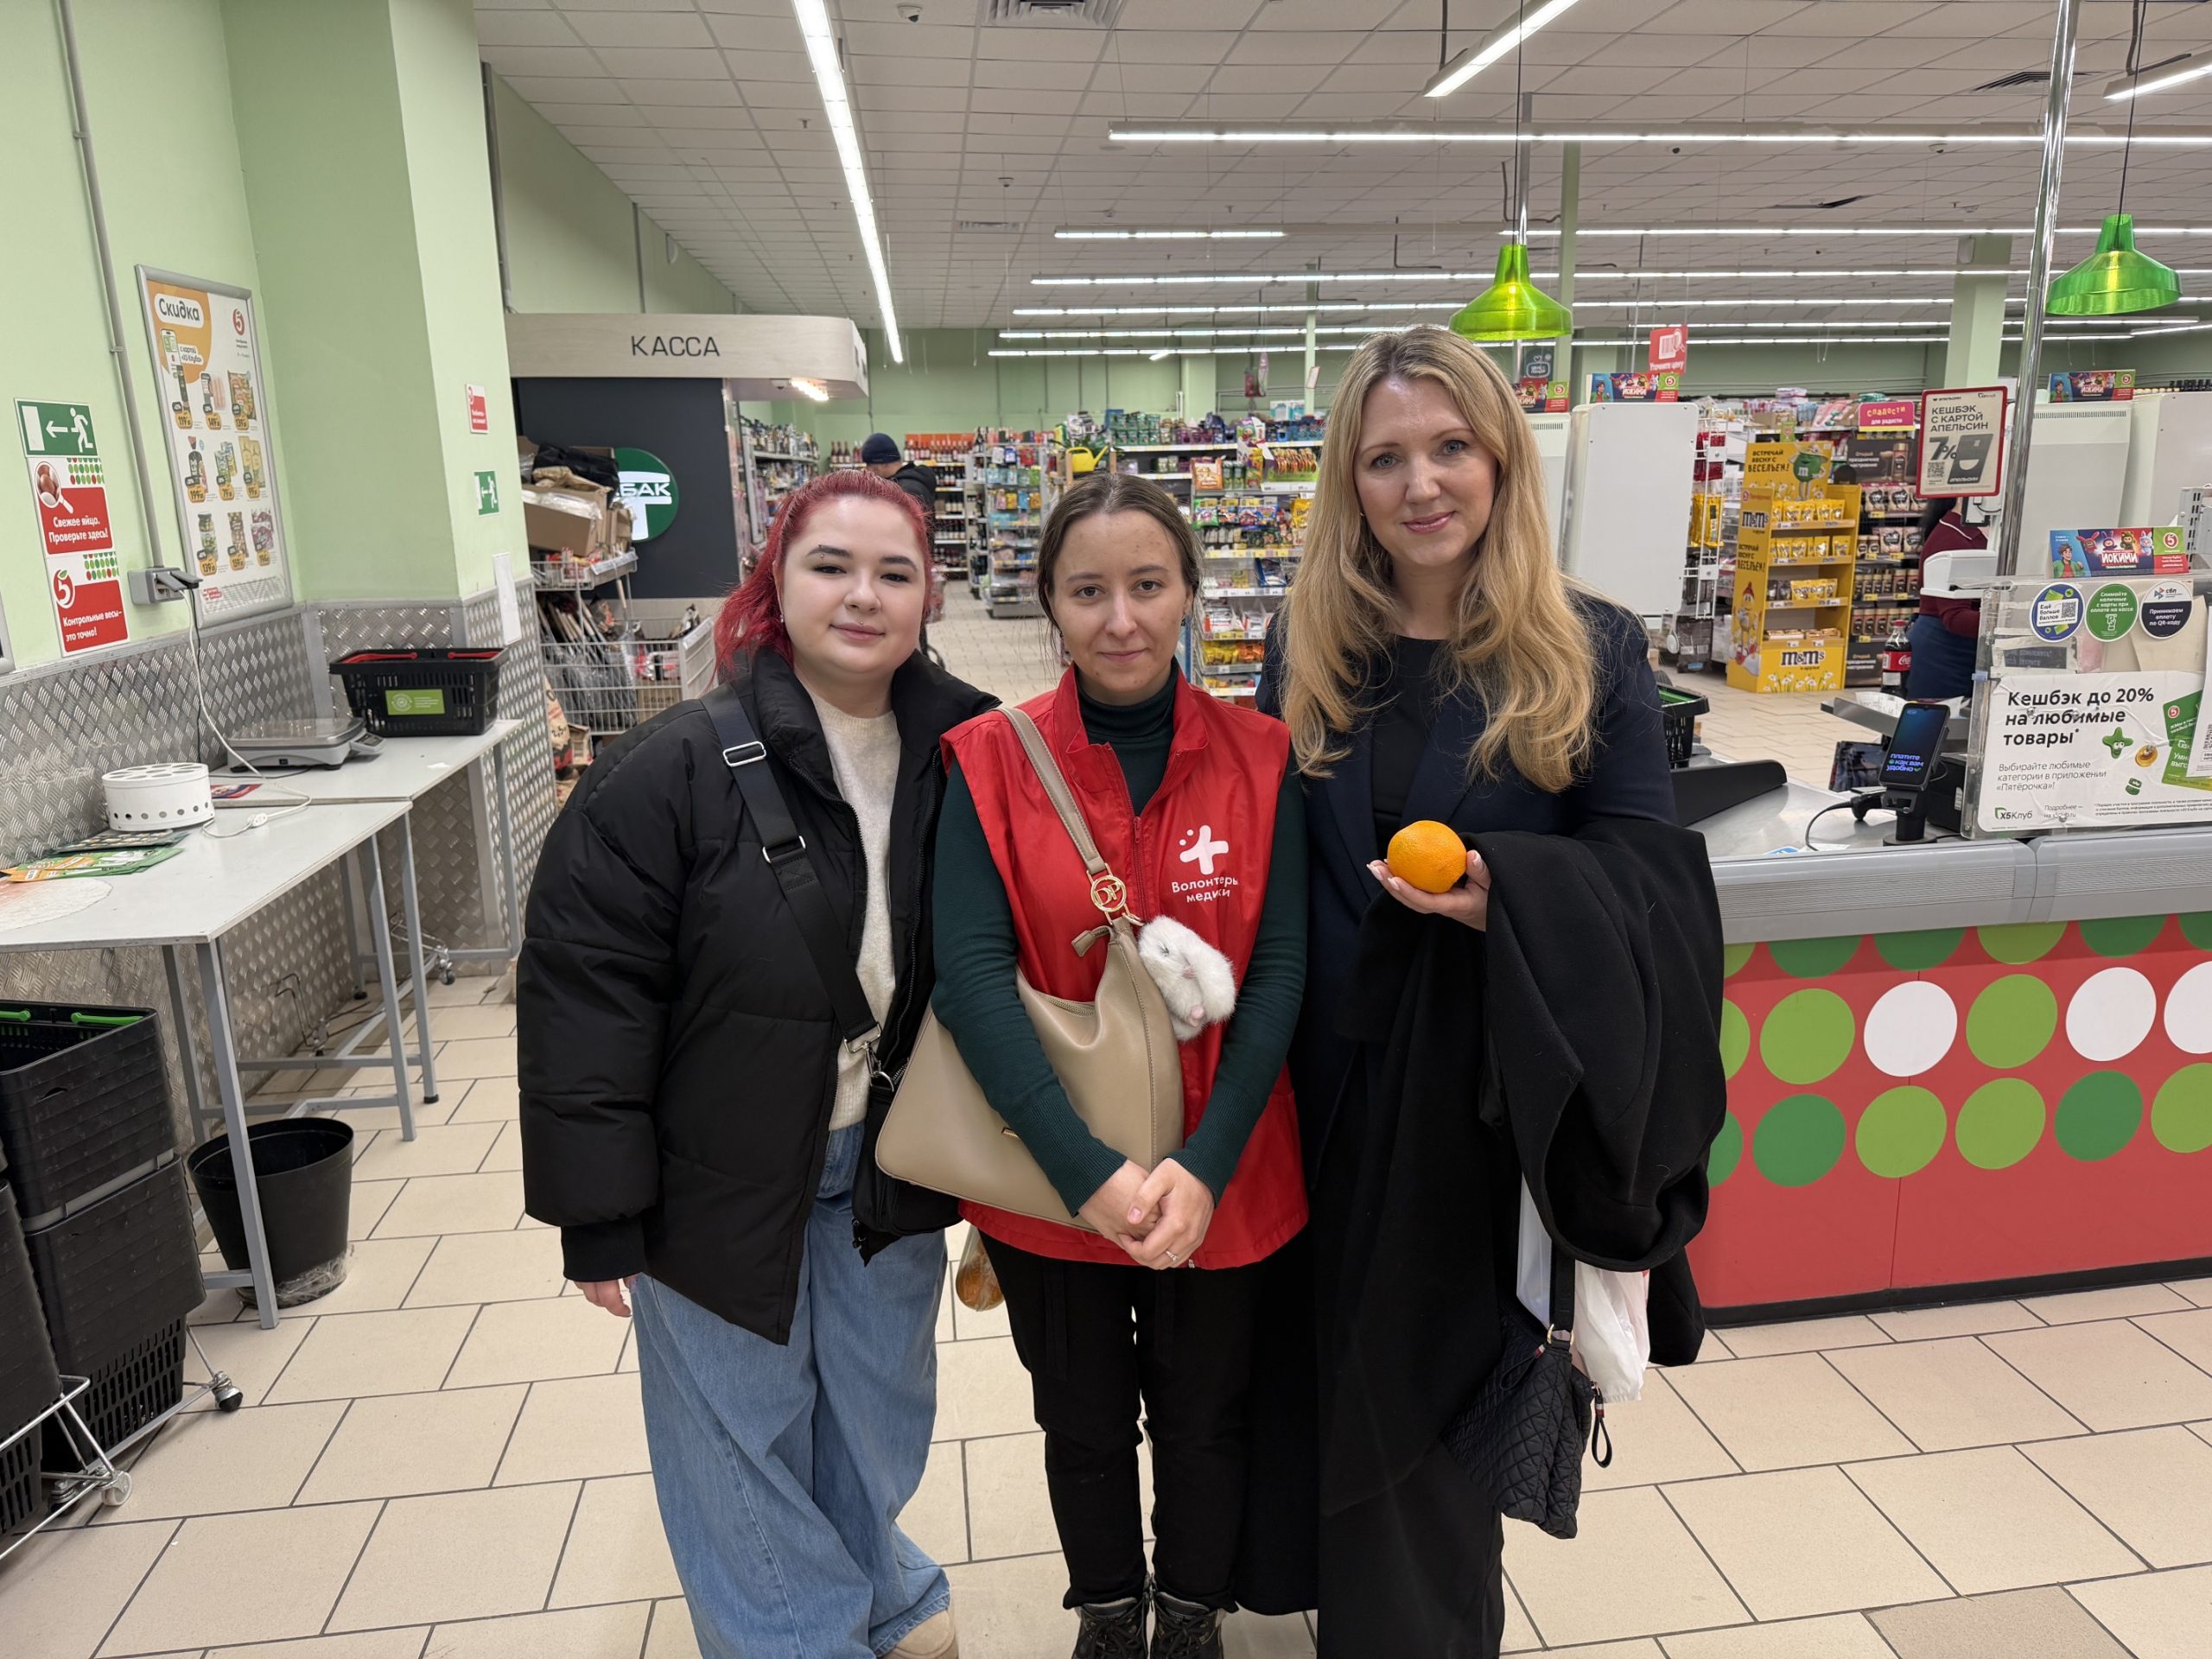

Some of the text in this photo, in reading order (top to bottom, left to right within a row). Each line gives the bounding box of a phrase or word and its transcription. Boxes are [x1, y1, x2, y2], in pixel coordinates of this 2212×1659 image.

[159, 298, 200, 321] Скидка
[632, 336, 720, 357] КАССА
[1932, 405, 1976, 415] КЕШБЭК
[1941, 412, 1983, 423] КАРТОЙ
[1930, 422, 1988, 432] АПЕЛЬСИН
[1929, 436, 1957, 461] 7%
[1748, 463, 1789, 473] ВЕСЕЛЬЕМ!
[54, 515, 100, 528] Свежее яйцо.
[48, 528, 109, 545] Проверьте здесь!
[62, 613, 104, 627] Контрольные
[77, 626, 97, 639] точно!
[2008, 688, 2154, 706] Кешбэк до 20%
[2005, 709, 2126, 726] на любимые
[1999, 760, 2091, 772] Выбирайте любимые
[1998, 773, 2044, 782] категории
[2051, 771, 2107, 780] приложении
[1997, 781, 2056, 792] «Пятёрочка»!
